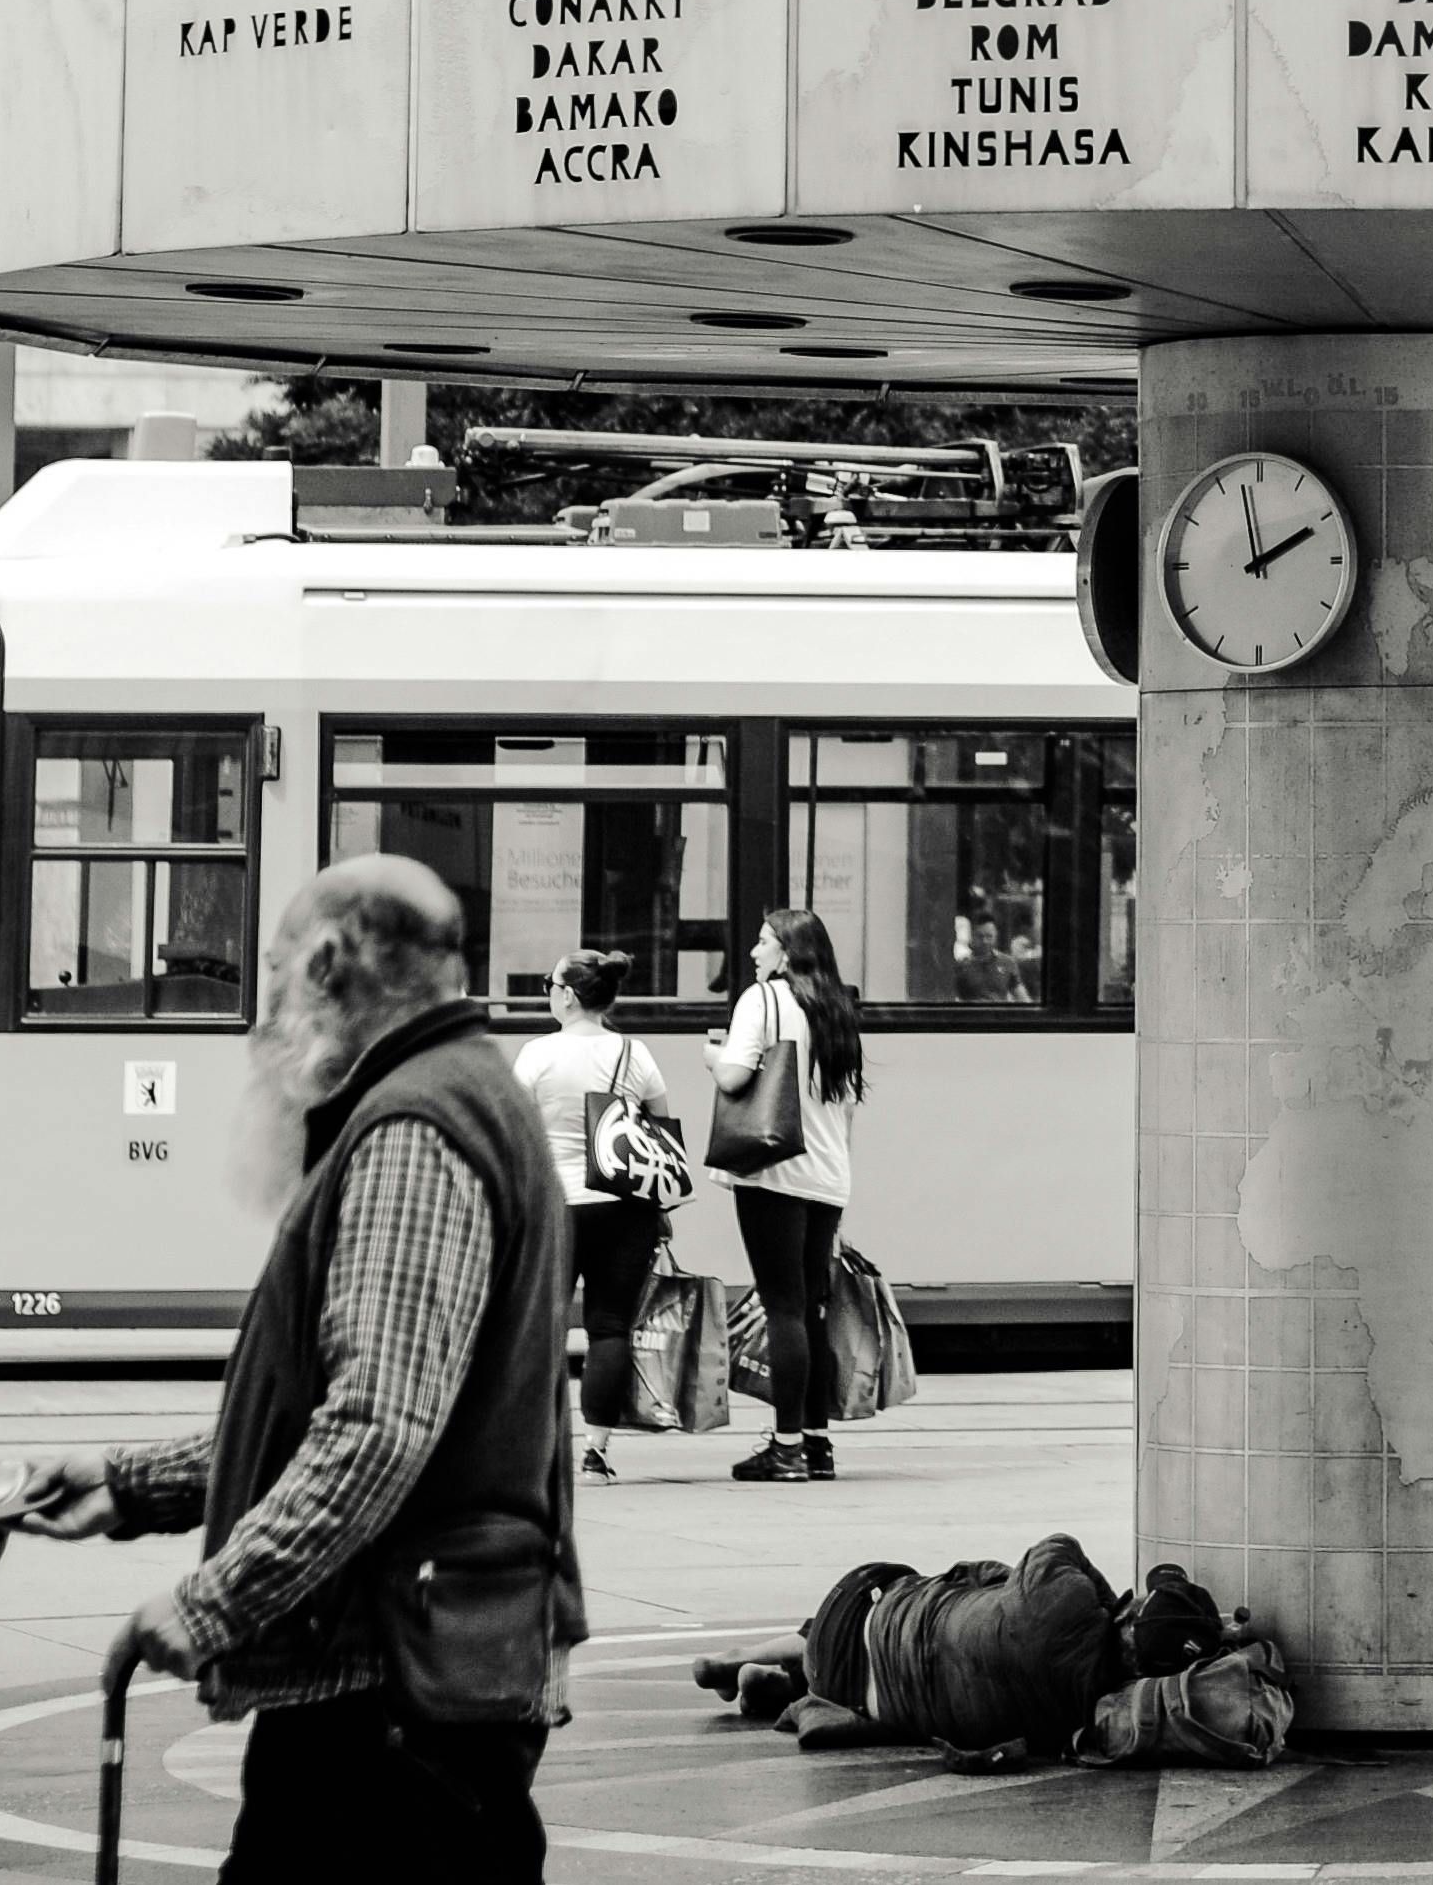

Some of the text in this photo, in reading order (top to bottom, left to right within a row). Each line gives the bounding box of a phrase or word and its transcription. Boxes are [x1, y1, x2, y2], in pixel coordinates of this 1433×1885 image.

[180, 5, 352, 58] KAP VERDE
[970, 23, 1059, 62] ROM
[532, 37, 663, 80] DAKAR
[515, 88, 678, 134] BAMAKO
[950, 76, 1079, 115] TUNIS
[533, 142, 661, 185] ACCRA
[897, 128, 1132, 169] KINSHASA
[128, 1141, 168, 1161] BVG
[11, 1292, 61, 1316] 1226
